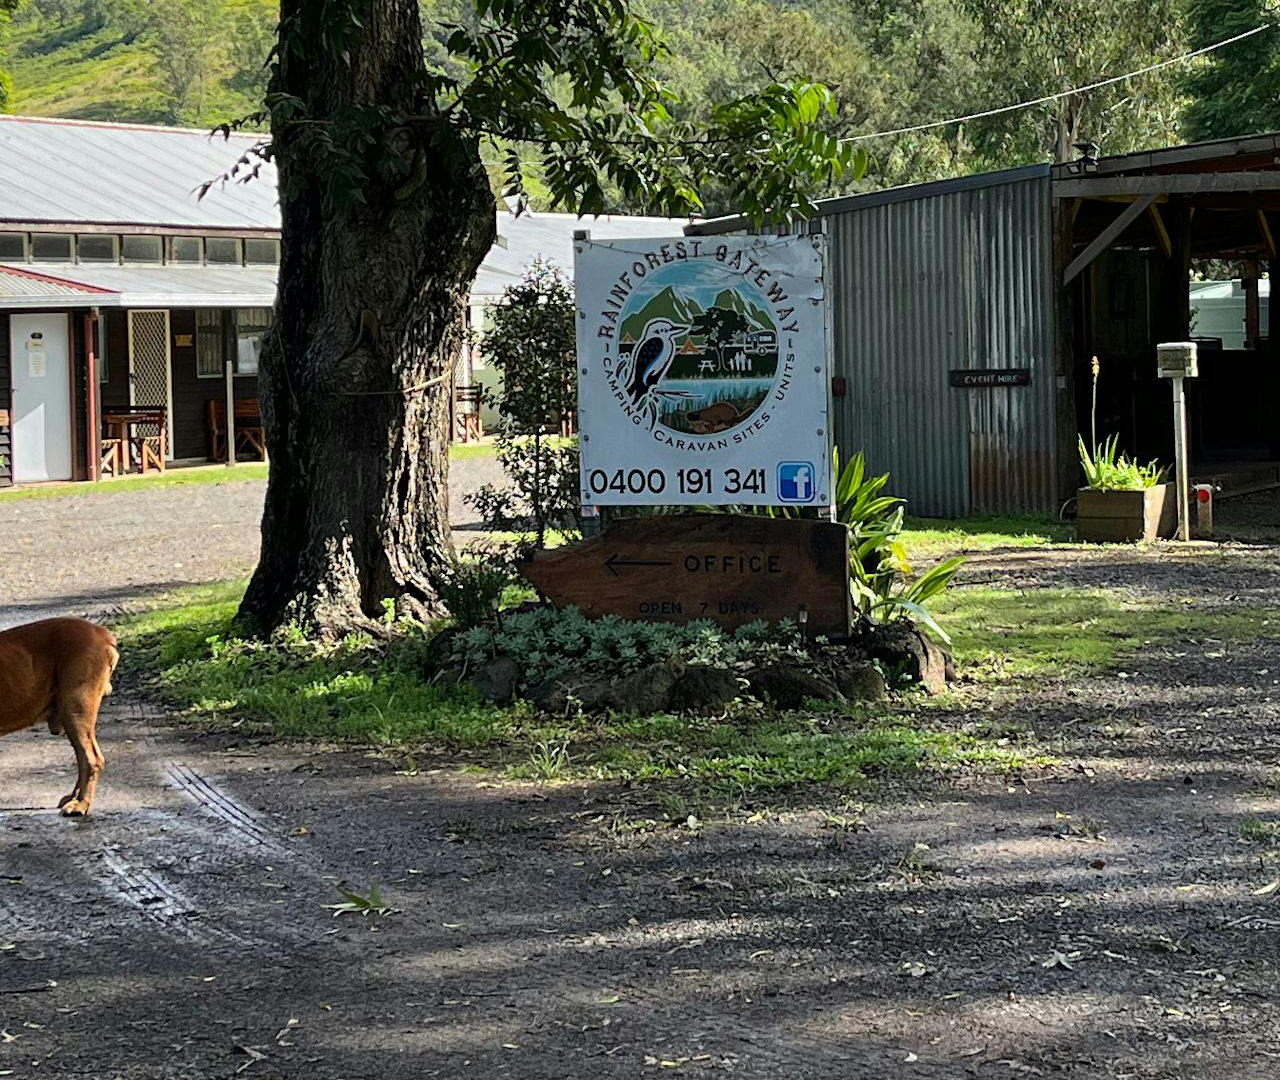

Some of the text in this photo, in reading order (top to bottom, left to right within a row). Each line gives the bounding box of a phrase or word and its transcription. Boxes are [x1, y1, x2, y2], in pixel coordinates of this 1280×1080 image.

[597, 240, 799, 340] RAINFOREST GATEWAY
[963, 374, 996, 384] EVENT
[602, 352, 795, 452] CAMPING CARAVAN SITES UNITS
[589, 468, 766, 495] 0400 191 341
[638, 601, 760, 615] OPEN 7 DAYS
